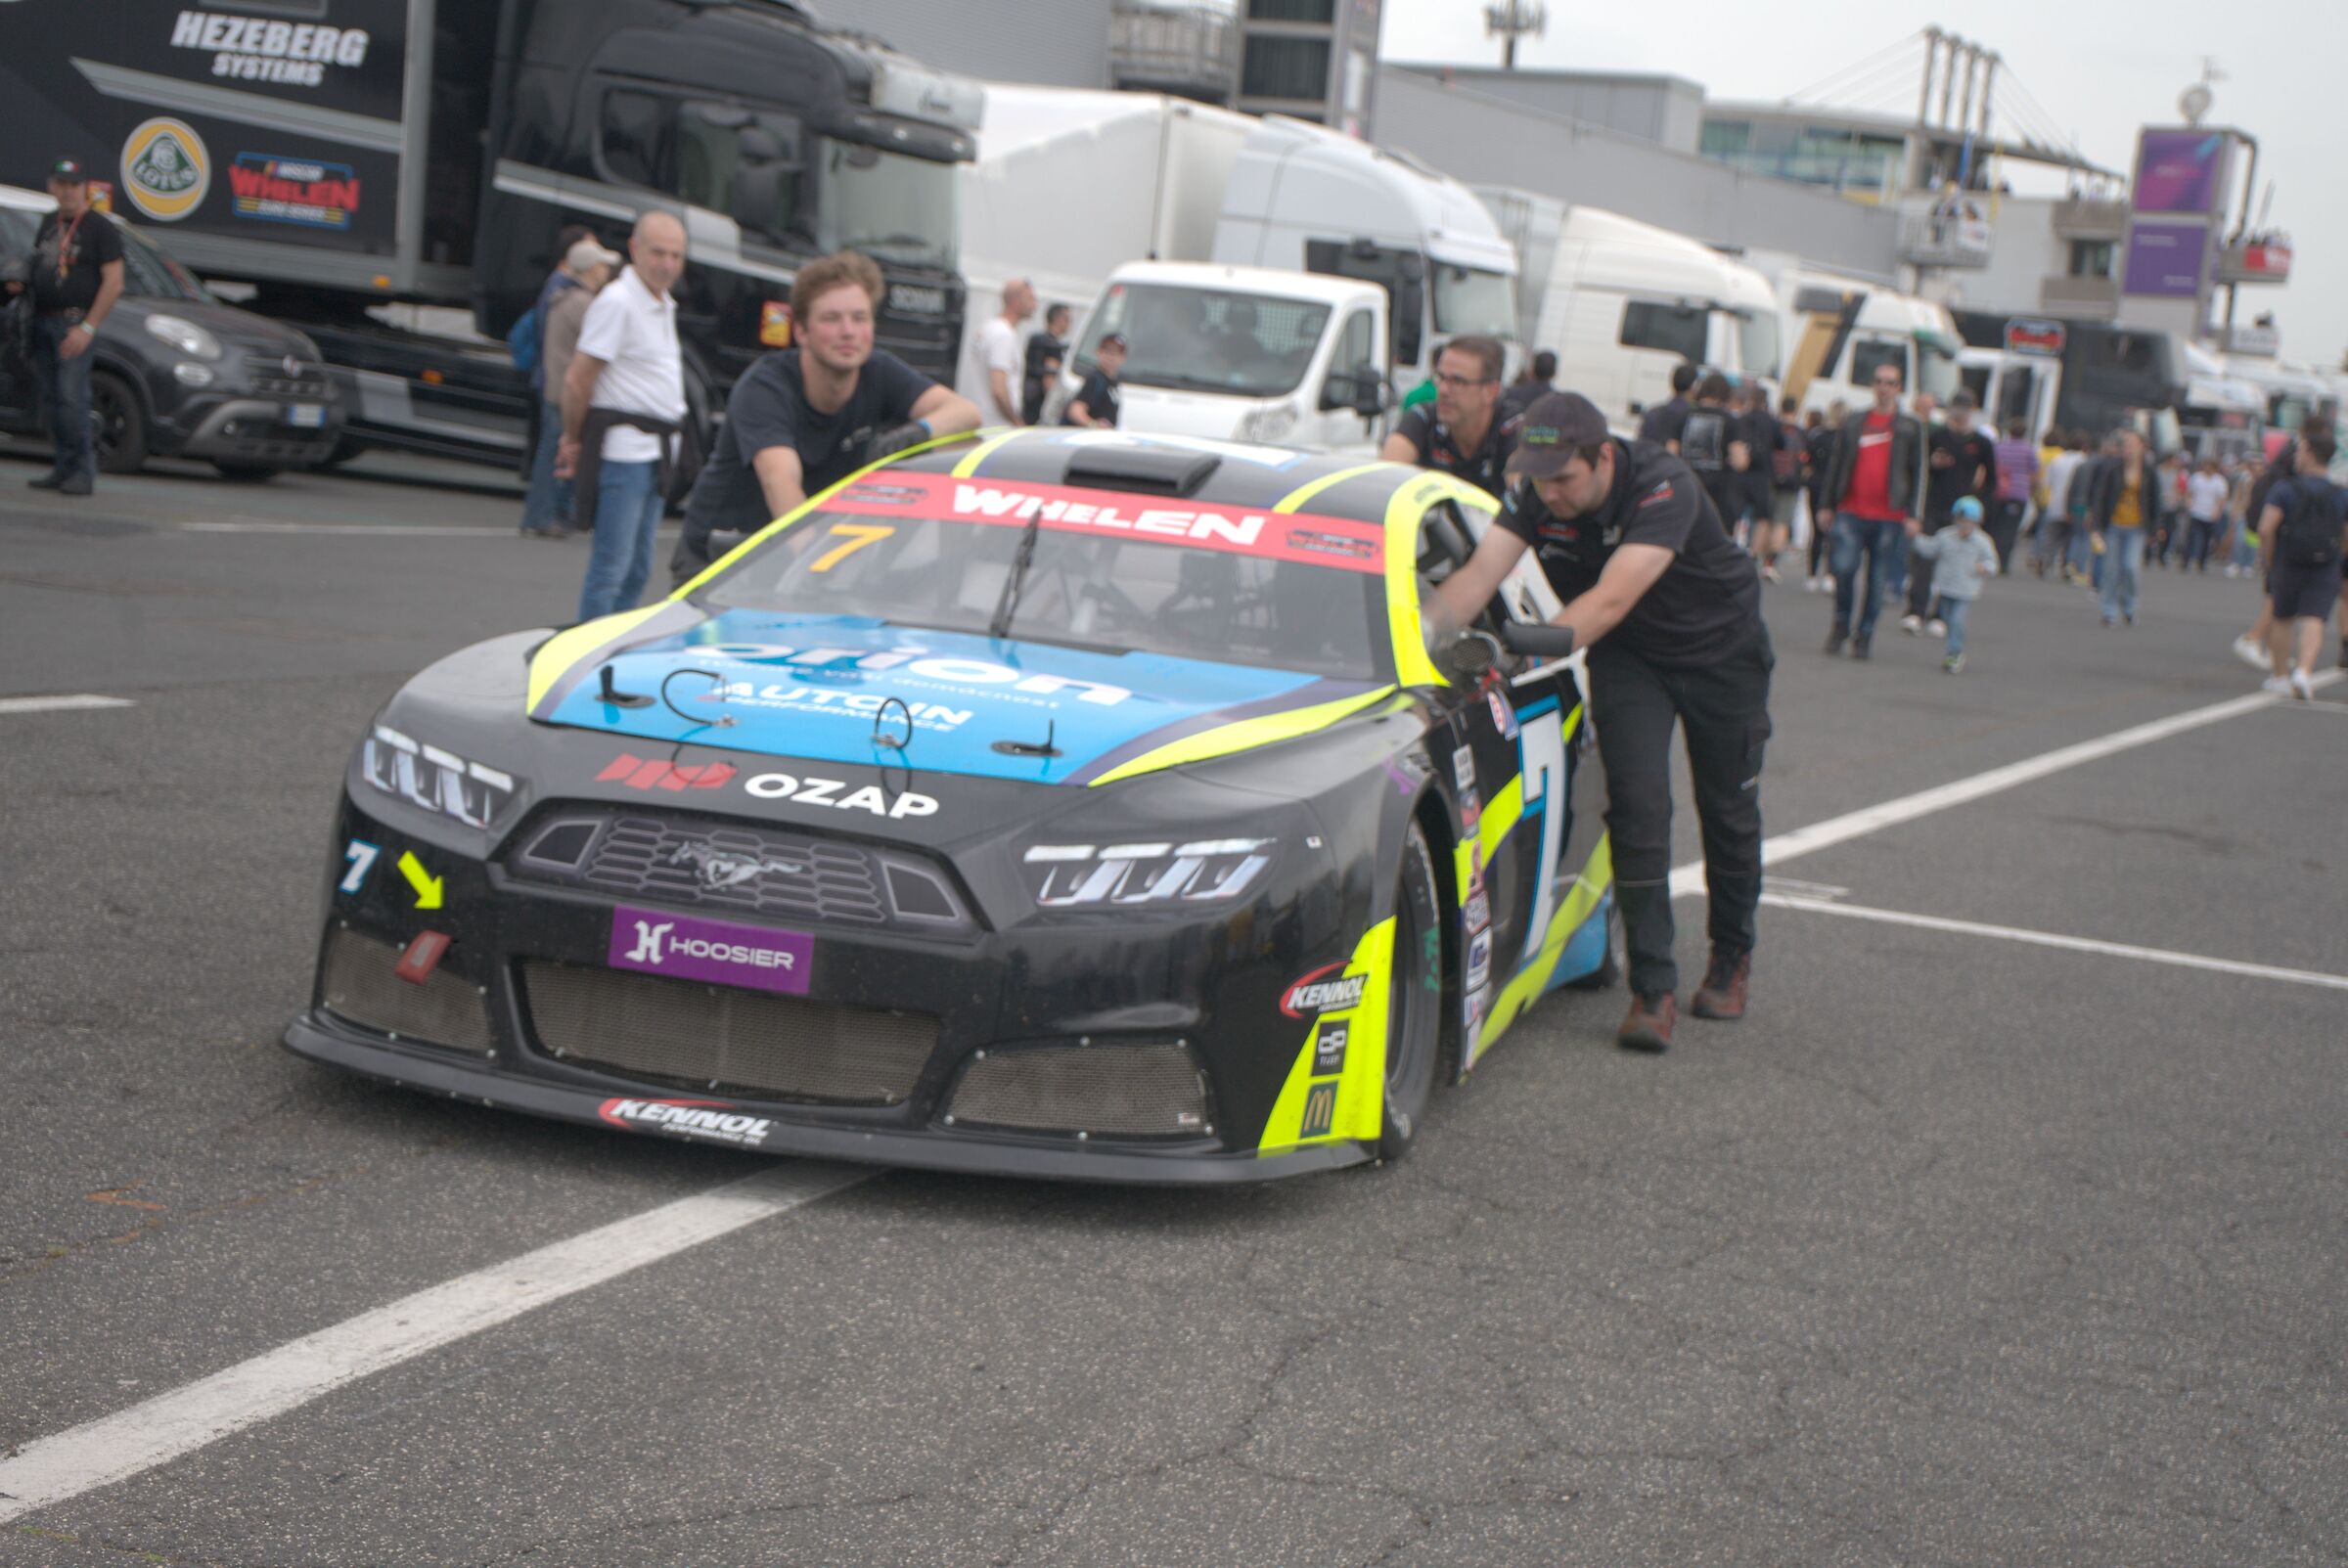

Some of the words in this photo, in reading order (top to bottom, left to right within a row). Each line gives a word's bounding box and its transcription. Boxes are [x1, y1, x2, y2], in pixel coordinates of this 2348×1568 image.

[169, 10, 370, 67] HEZEBERG
[211, 52, 325, 86] SYSTEMS
[131, 160, 198, 191] LOTUS
[229, 163, 360, 212] WHELEN
[953, 484, 1266, 546] WHELEN
[808, 523, 896, 572] 7
[683, 643, 1133, 706] orion
[724, 695, 956, 733] PERFORMANCE
[744, 773, 939, 819] OZAP
[1517, 694, 1565, 963] 7
[339, 838, 382, 896] 7
[669, 936, 794, 970] HOOSIER
[1287, 974, 1366, 1009] KENNOL
[610, 1098, 771, 1138] KENNOL
